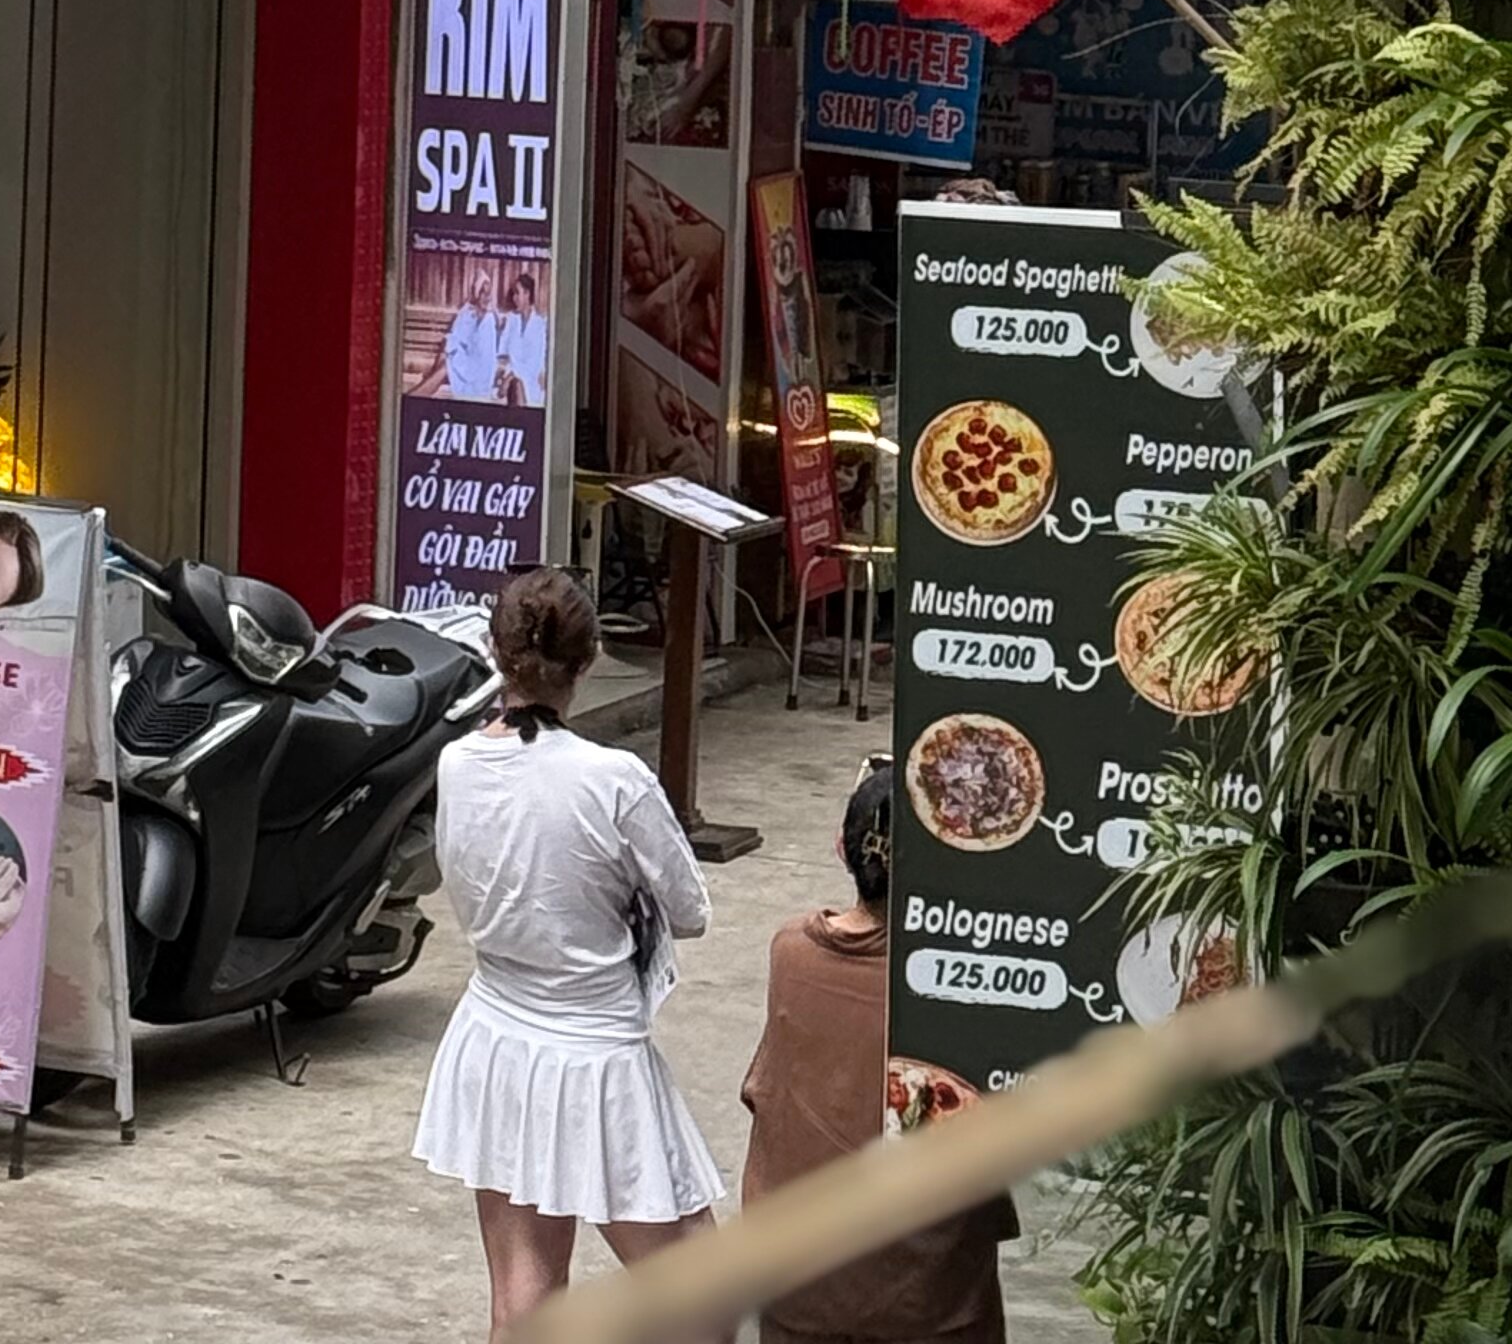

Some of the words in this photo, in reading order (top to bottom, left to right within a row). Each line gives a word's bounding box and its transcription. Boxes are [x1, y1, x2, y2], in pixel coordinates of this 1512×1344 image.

[823, 18, 972, 91] COFFEE
[817, 90, 880, 135] SINH
[416, 127, 499, 217] SPA
[506, 134, 550, 221] II
[913, 253, 1010, 289] Seafood
[974, 314, 1070, 346] 125.000
[416, 412, 468, 455] LÀM
[471, 423, 527, 464] NAIL
[1126, 432, 1254, 474] Pepperon
[404, 459, 438, 509] CỔ
[441, 477, 481, 514] VAI
[485, 475, 536, 520] GÁY
[418, 524, 459, 577] GỘI
[910, 580, 1055, 626] Mushroom
[935, 637, 1037, 672] 172.000
[904, 896, 1070, 949] Bolognese
[932, 958, 1047, 997] 125.000
